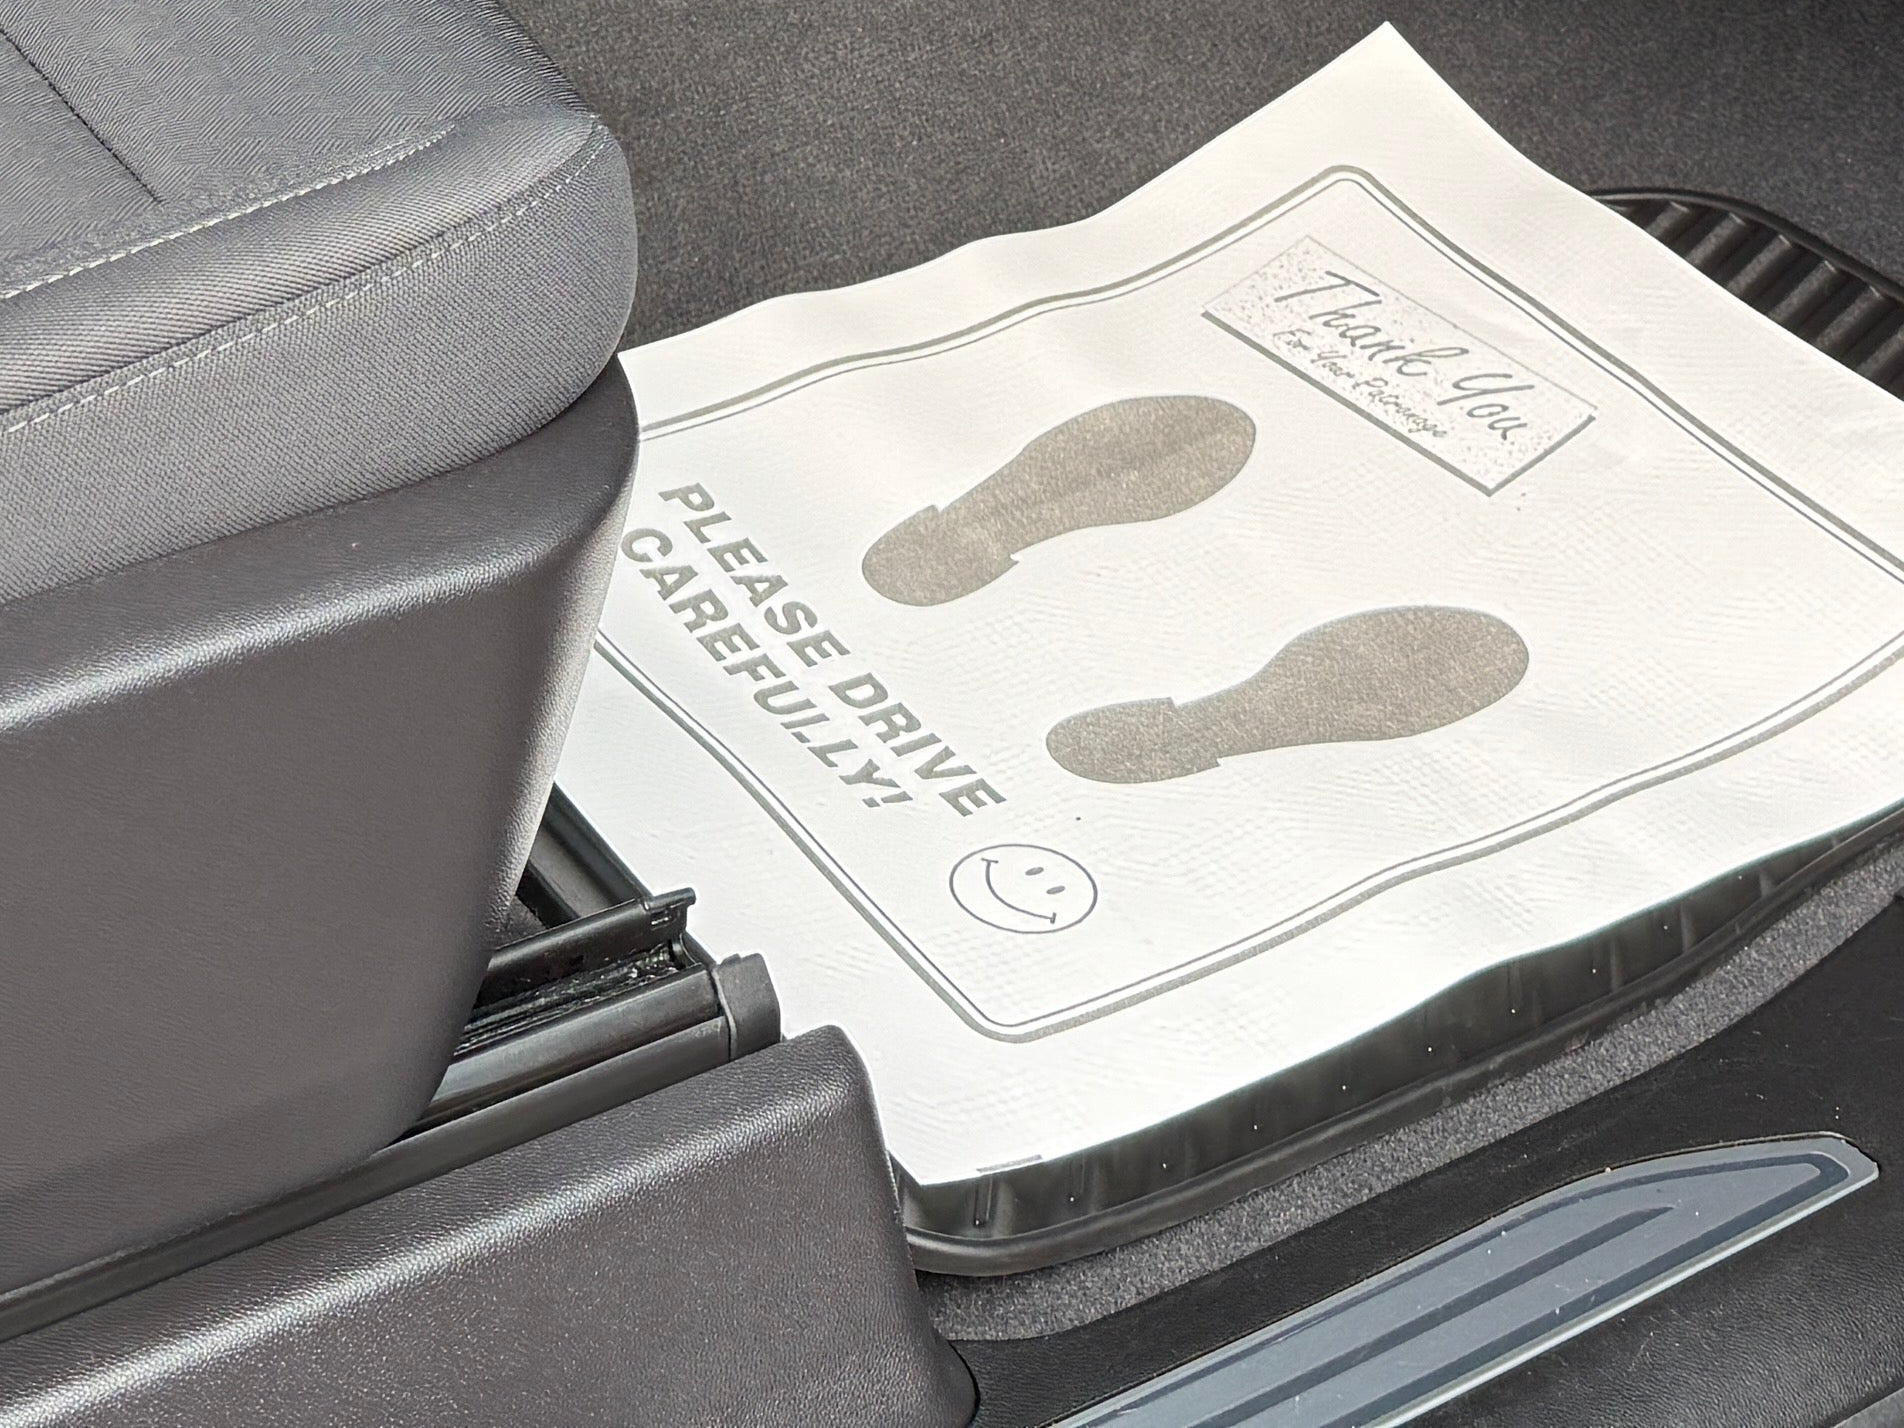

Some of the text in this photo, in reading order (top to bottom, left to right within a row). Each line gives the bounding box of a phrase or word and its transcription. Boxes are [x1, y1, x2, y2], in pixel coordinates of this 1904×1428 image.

[1273, 270, 1536, 441] Thank You
[620, 527, 914, 809] CAREFULLY!
[658, 482, 1007, 817] PLEASE DRIVE
